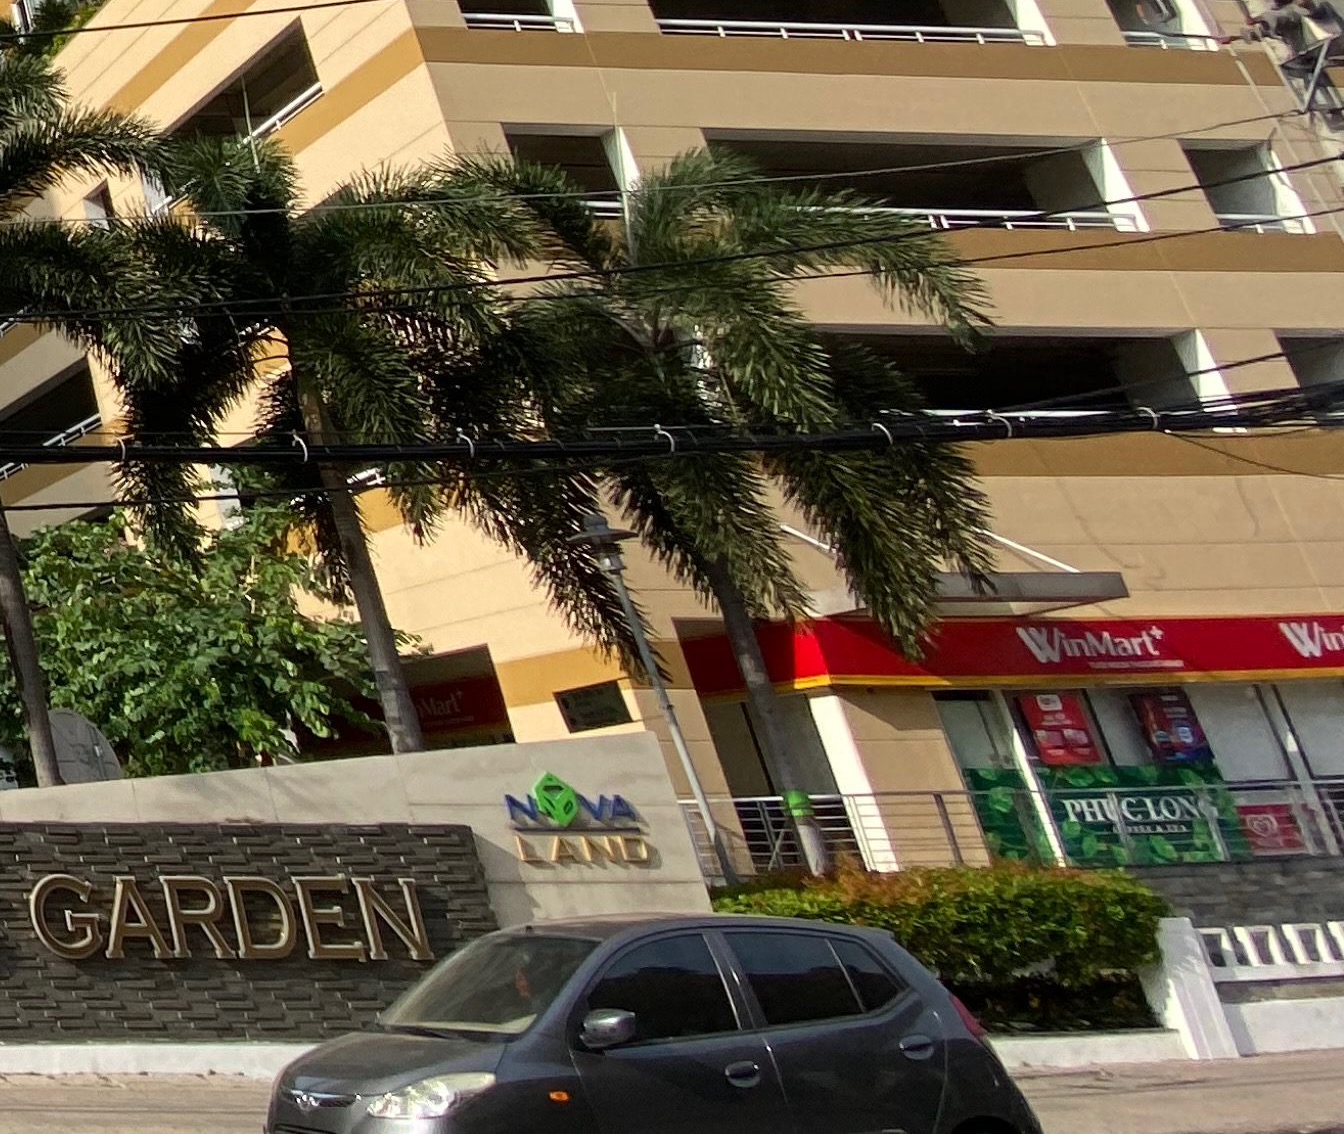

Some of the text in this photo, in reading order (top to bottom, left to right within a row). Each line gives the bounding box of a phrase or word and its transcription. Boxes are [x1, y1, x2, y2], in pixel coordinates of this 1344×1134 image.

[1278, 621, 1344, 658] Win
[515, 834, 649, 862] LAND
[28, 872, 435, 962] GARDEN
